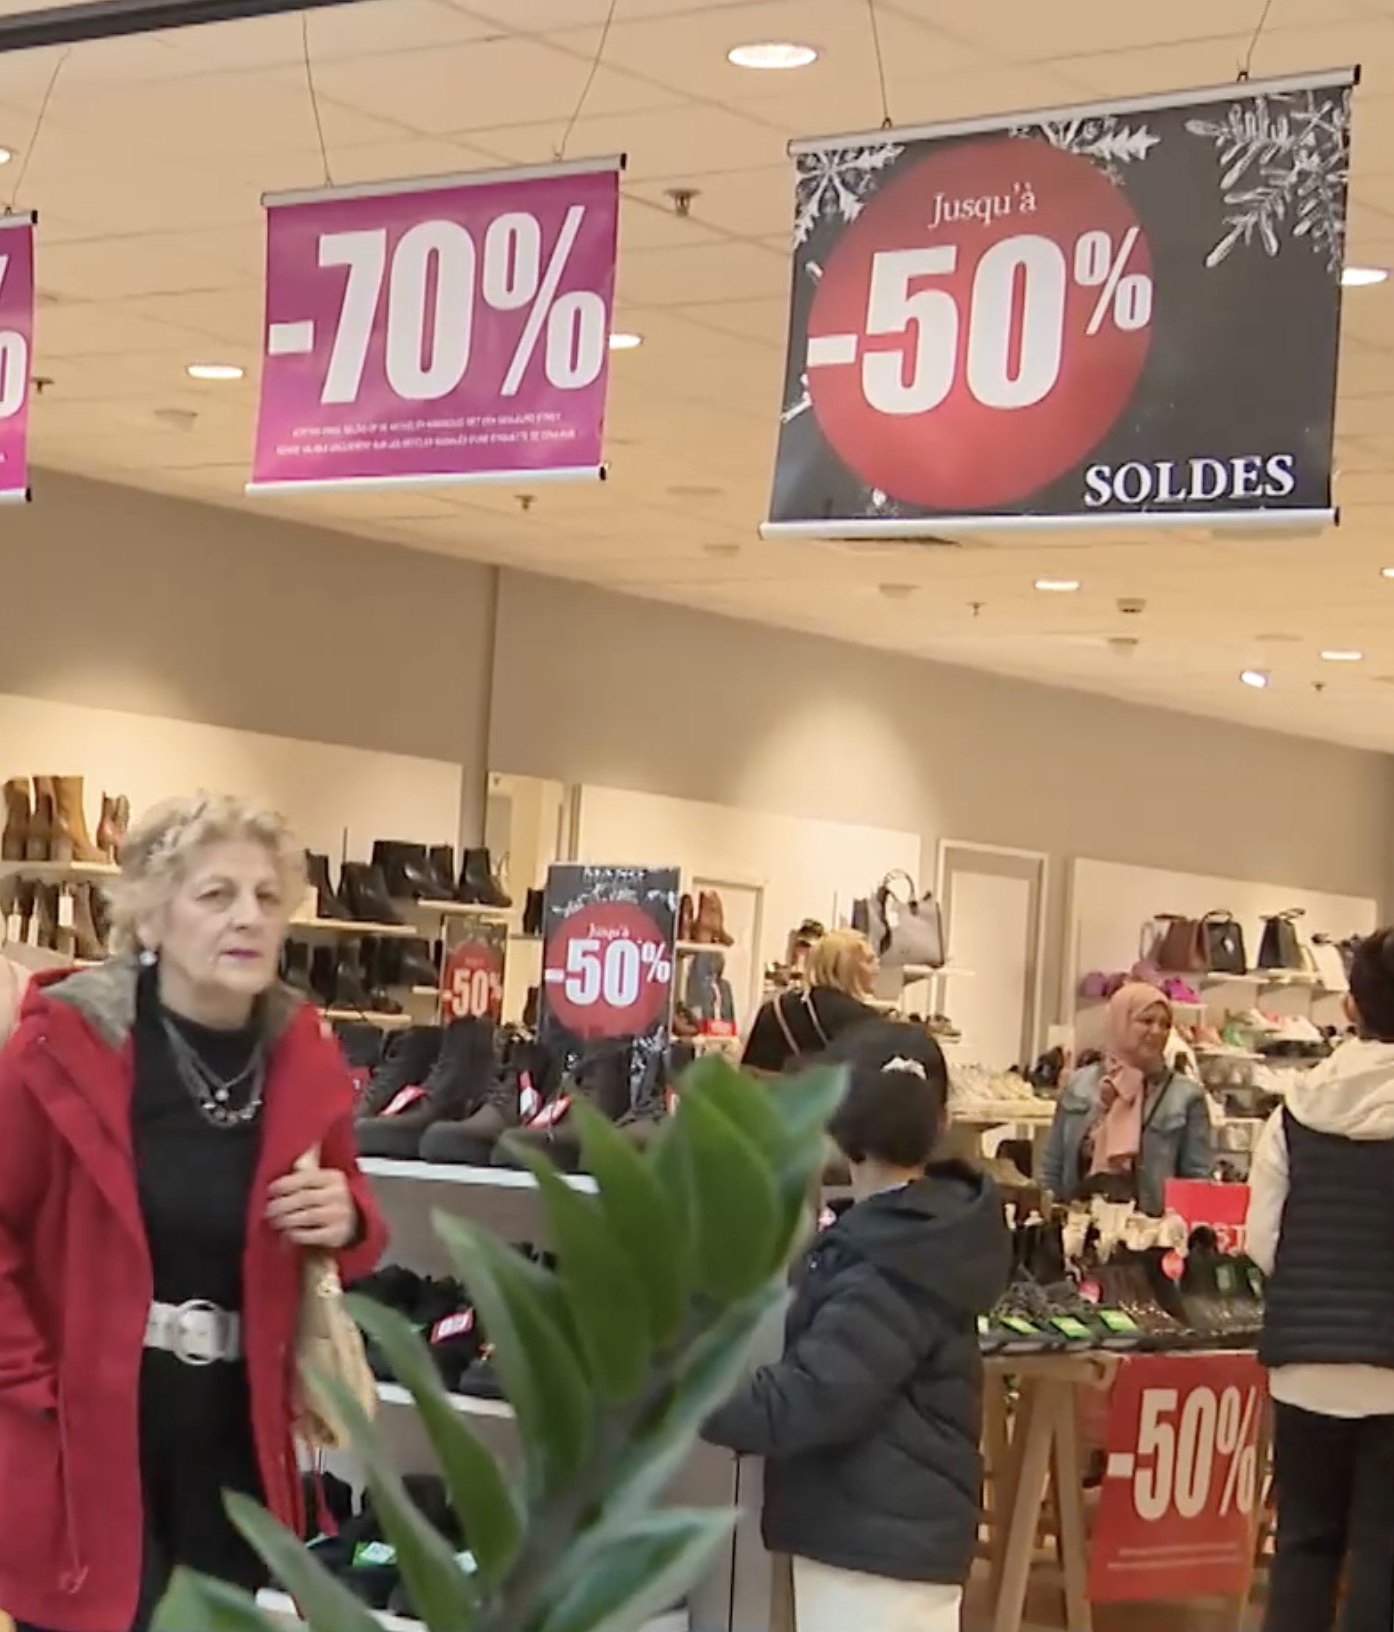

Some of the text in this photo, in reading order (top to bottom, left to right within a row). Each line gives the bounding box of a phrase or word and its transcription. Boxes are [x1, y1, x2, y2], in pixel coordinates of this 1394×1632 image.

[928, 181, 1038, 231] Jusqu'à
[268, 205, 606, 404] -70%
[807, 226, 1154, 415] -50%
[1083, 454, 1296, 507] SOLDES
[442, 968, 502, 1016] -50%
[545, 939, 670, 1007] -50%
[1107, 1386, 1255, 1521] -50%
